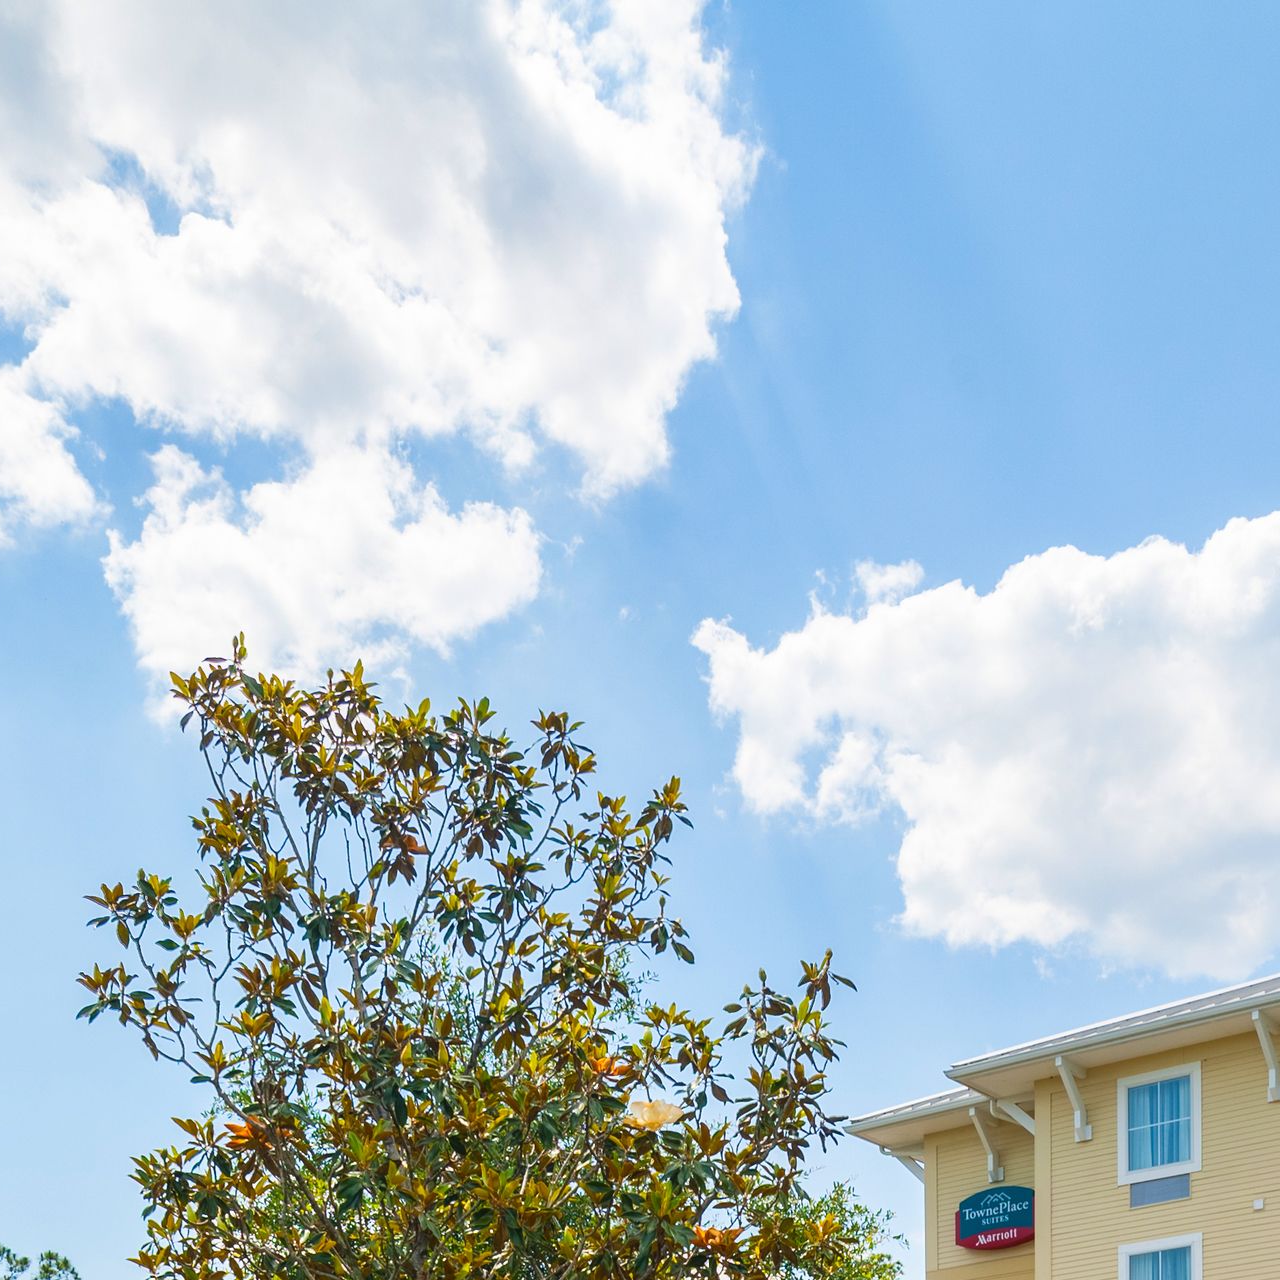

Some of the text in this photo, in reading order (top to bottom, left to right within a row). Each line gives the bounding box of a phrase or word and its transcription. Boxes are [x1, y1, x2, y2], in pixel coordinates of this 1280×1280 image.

[962, 1200, 1029, 1220] TownePlace
[981, 1214, 1009, 1225] SUITES
[975, 1228, 1017, 1246] Marriott
